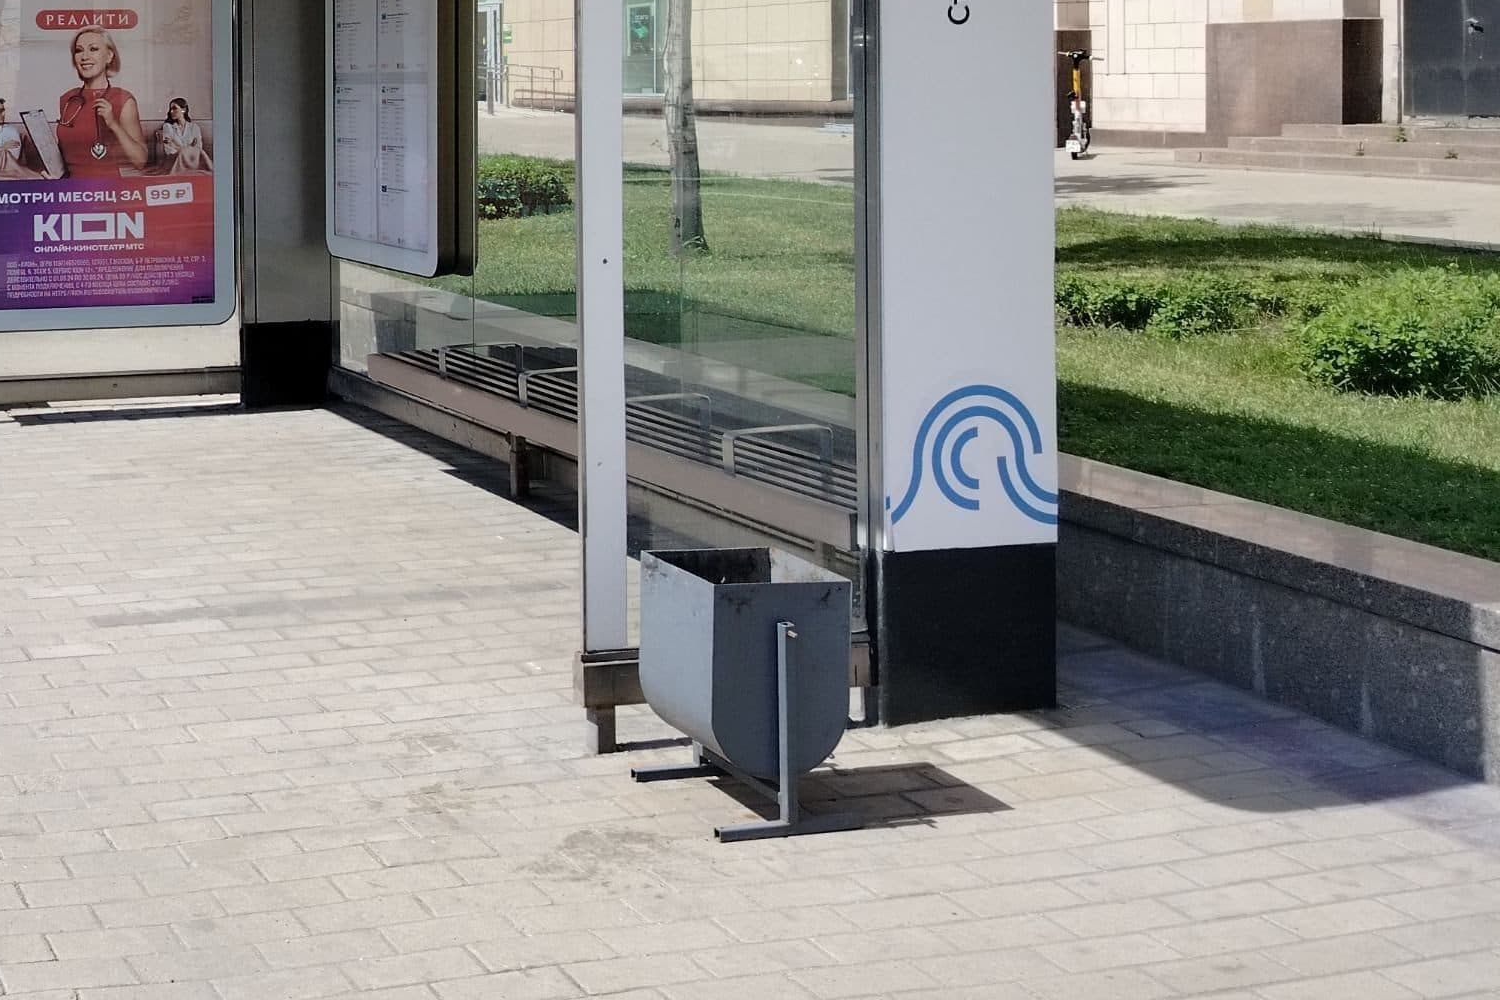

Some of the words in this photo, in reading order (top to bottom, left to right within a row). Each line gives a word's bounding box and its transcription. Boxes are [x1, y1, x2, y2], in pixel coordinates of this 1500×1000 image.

[45, 14, 130, 26] РЕАЛИТИ
[58, 190, 117, 203] МЕСЯЦ
[120, 190, 142, 201] ЗА
[150, 189, 170, 200] 99
[33, 211, 145, 242] KION
[34, 243, 124, 254] ОНЛАЙН-КИНОТЕАТР
[125, 242, 145, 251] МТС
